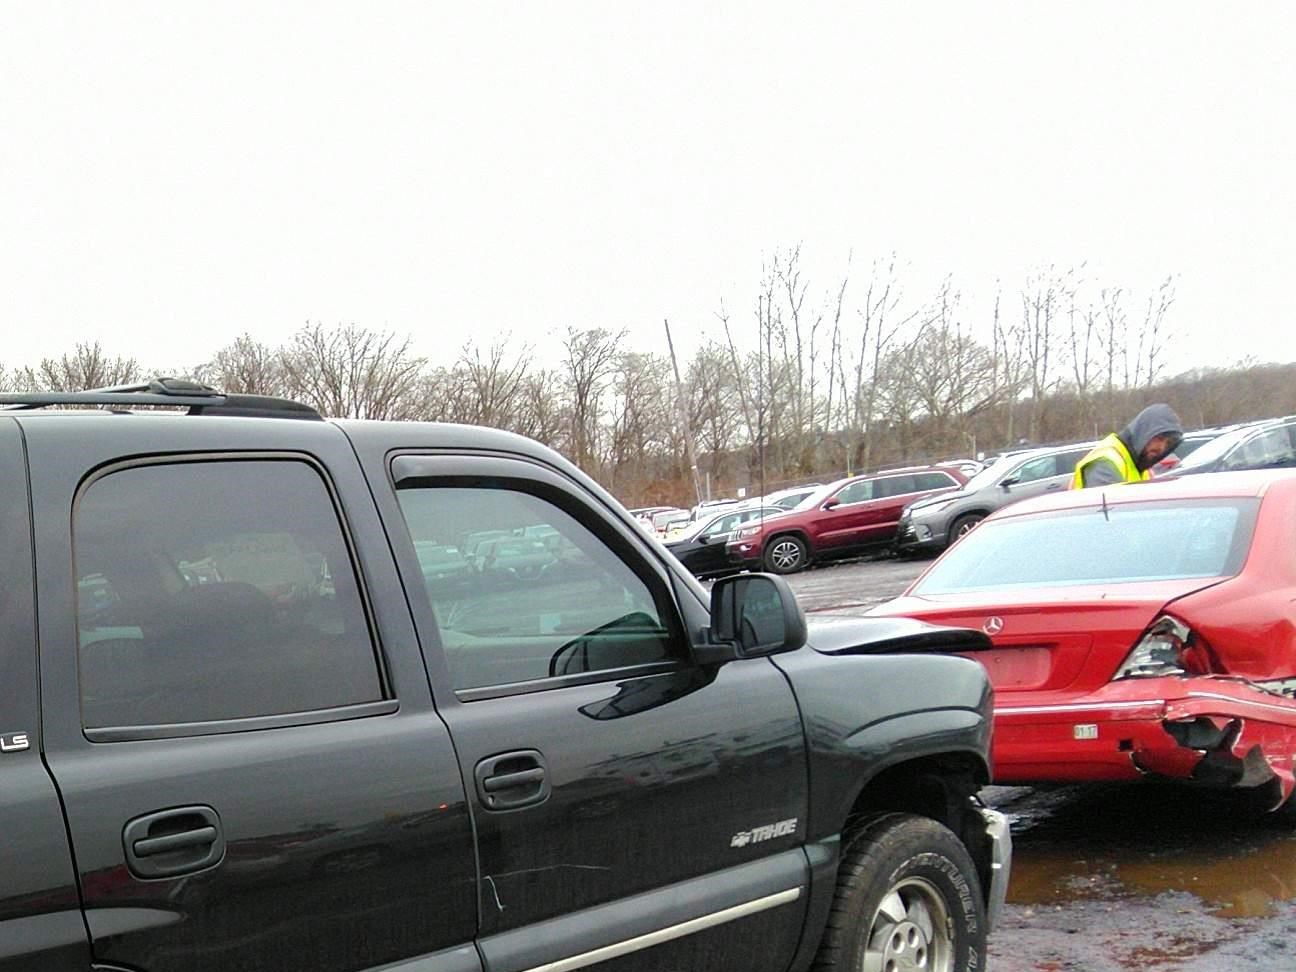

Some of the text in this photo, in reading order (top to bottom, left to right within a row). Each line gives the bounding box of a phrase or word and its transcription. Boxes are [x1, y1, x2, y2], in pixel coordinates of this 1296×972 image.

[0, 734, 29, 750] LS
[752, 817, 798, 843] TAHOE
[888, 851, 977, 934] VENTURER
